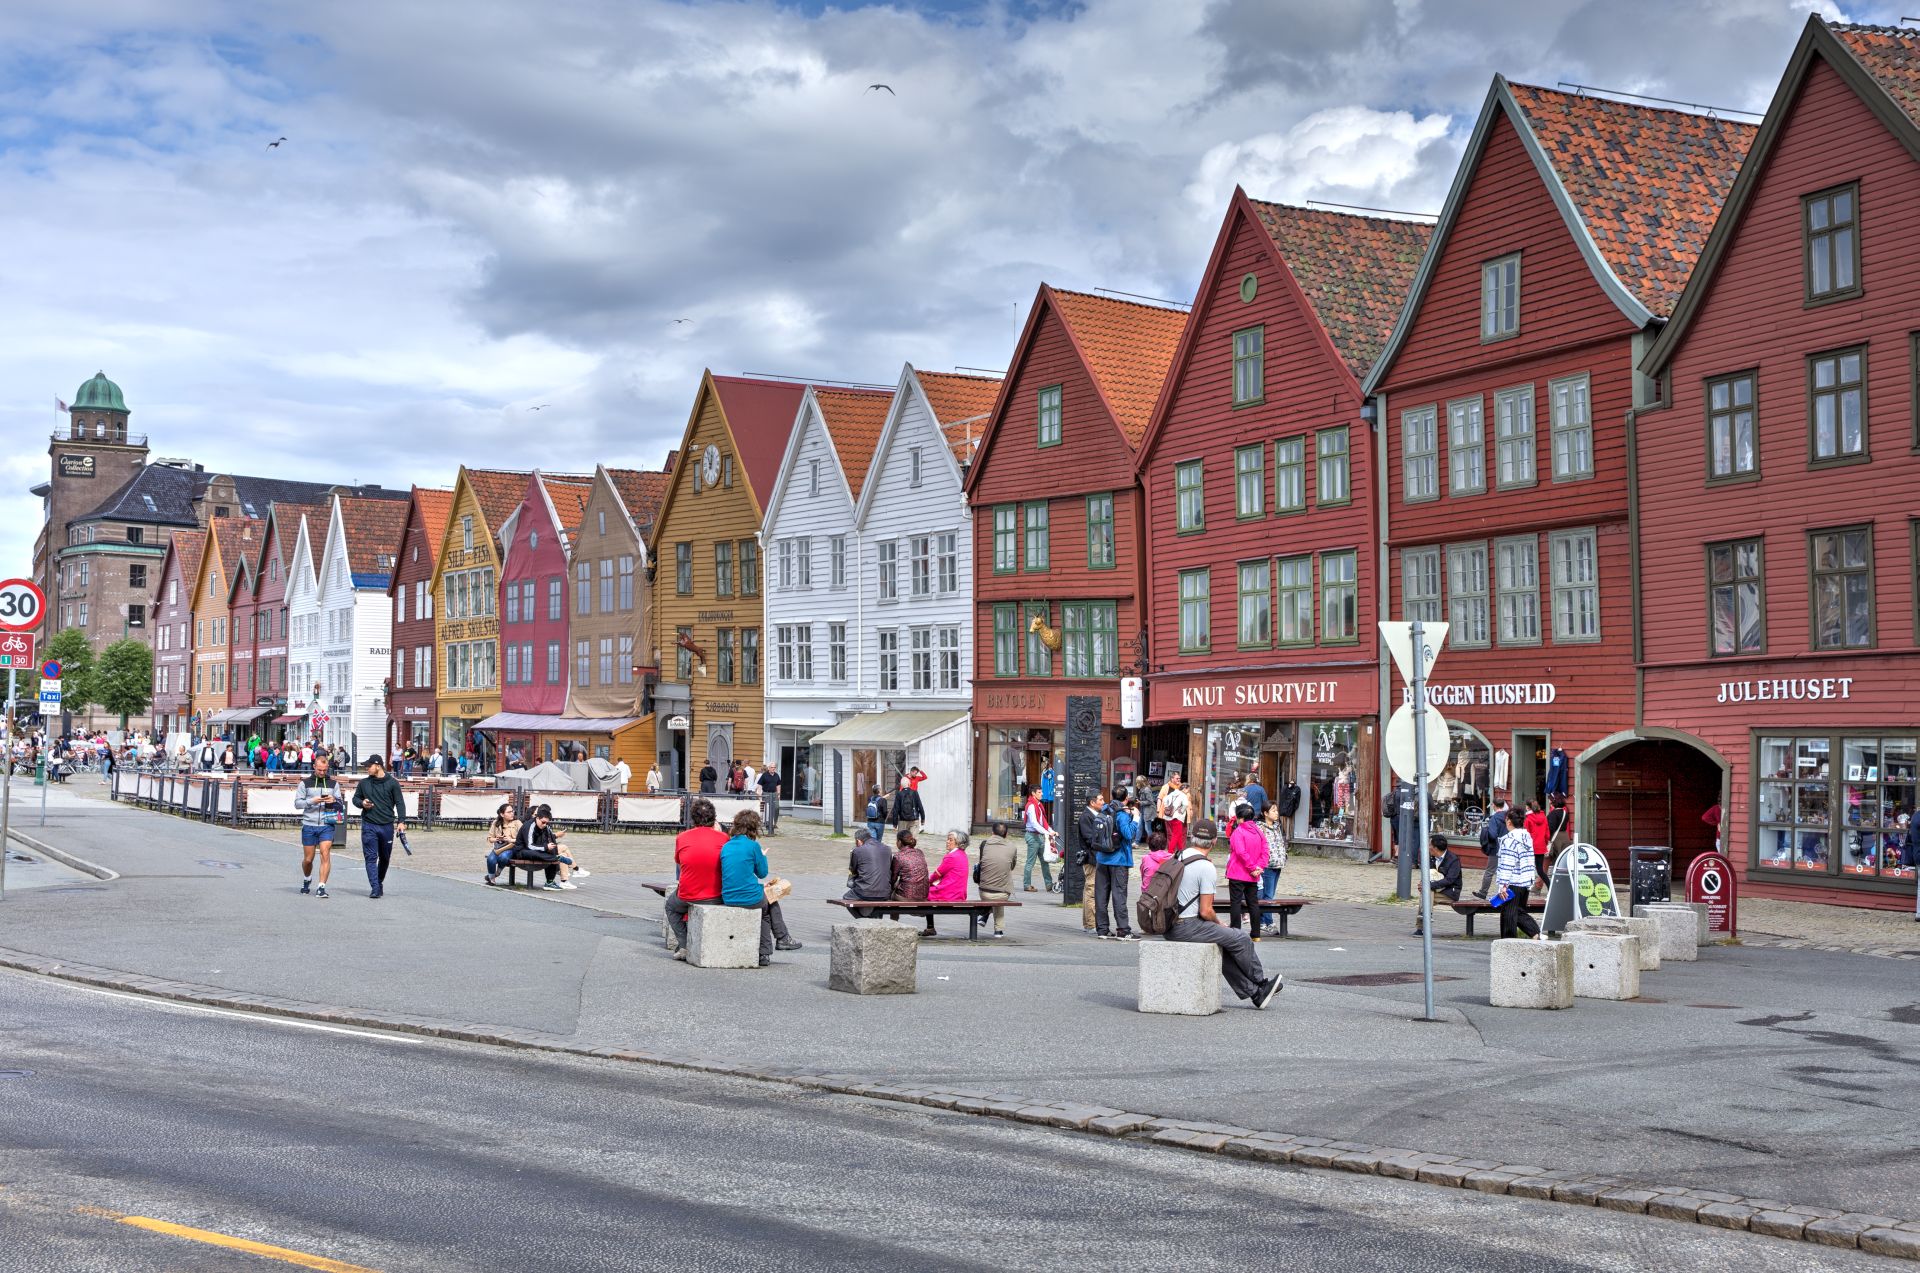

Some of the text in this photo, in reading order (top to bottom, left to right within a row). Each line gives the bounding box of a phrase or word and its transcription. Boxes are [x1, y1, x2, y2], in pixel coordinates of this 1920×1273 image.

[60, 456, 82, 465] Clarion
[65, 464, 94, 472] Collection
[447, 549, 465, 569] SILD
[0, 591, 36, 618] 30
[441, 623, 464, 640] ALFRED
[369, 647, 392, 655] RADI
[42, 692, 59, 700] Taxi
[1182, 681, 1338, 707] KNUT SKURTVEIT
[1402, 683, 1556, 705] BYGGEN HUSFLID
[1716, 677, 1853, 703] JULEHUSET
[986, 694, 1046, 712] BRYGGEN
